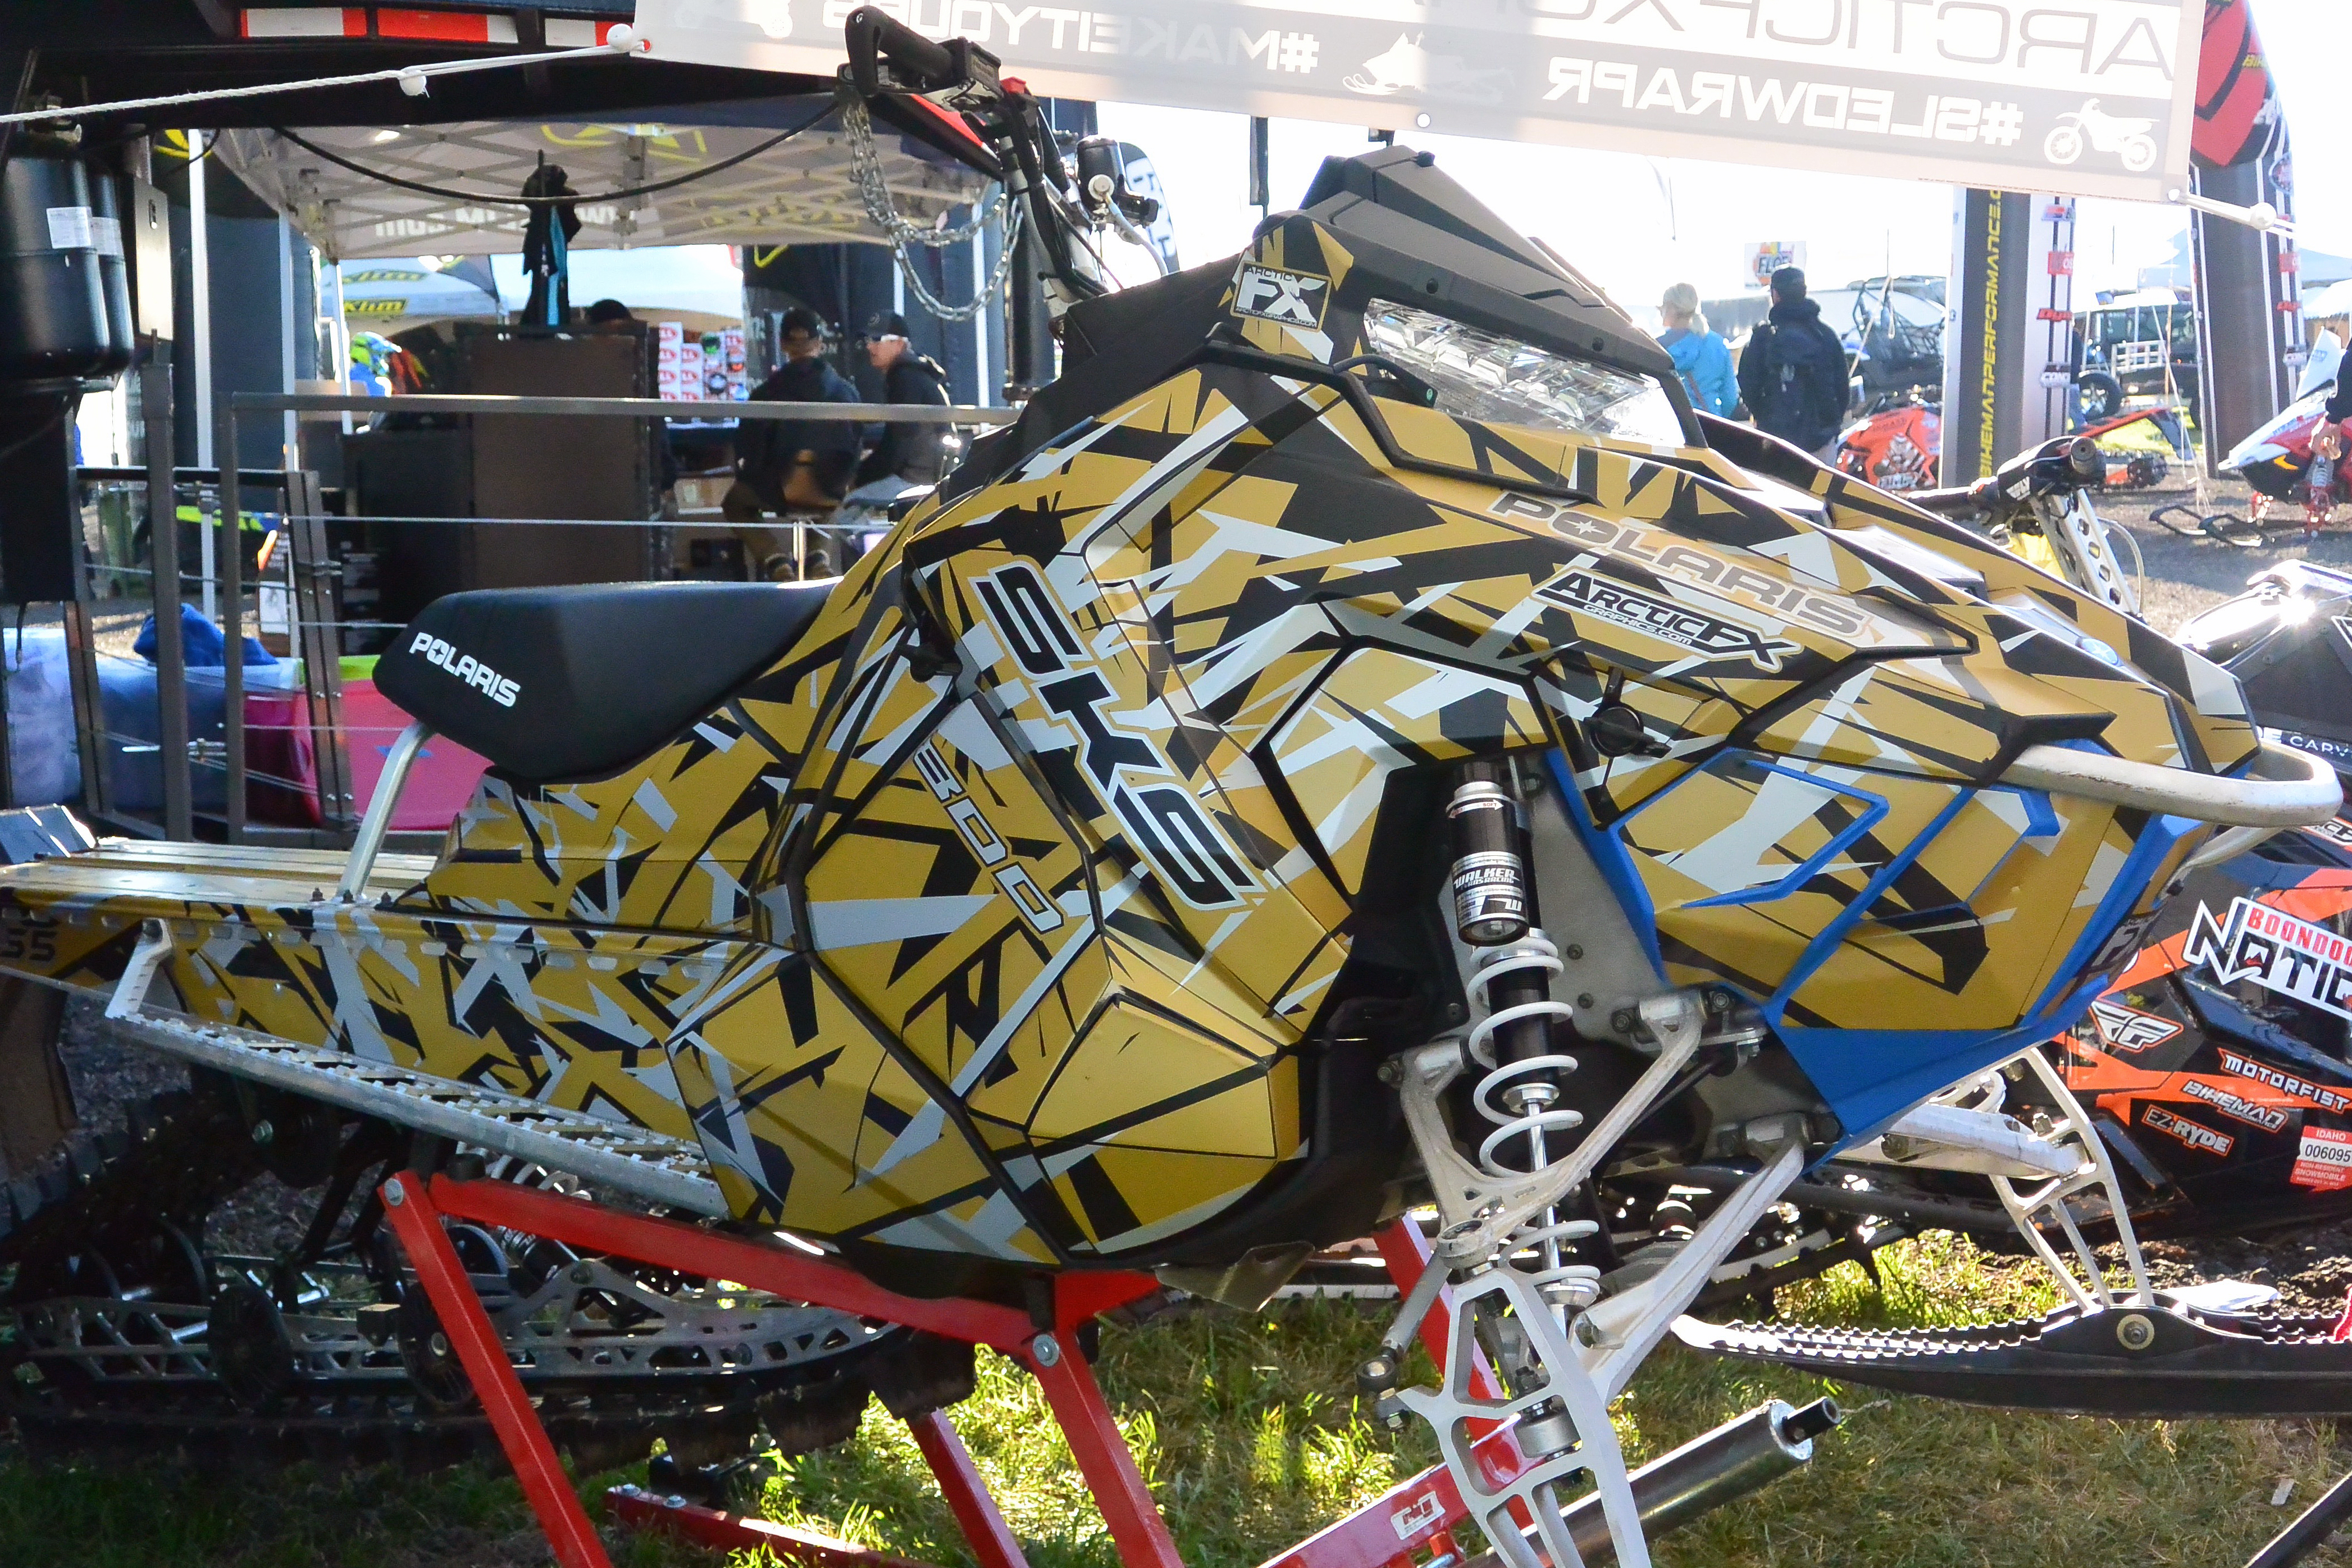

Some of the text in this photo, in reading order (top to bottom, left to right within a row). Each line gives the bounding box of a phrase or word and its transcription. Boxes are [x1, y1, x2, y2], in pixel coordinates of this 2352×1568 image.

[1237, 272, 1327, 323] FX
[1247, 266, 1292, 281] ARCTIC
[1490, 492, 1871, 636] POLARIS
[1546, 571, 1799, 666] ARCTICFX
[408, 632, 521, 708] POLARIS
[969, 561, 1267, 910] SKS
[913, 744, 1063, 935] 800
[1453, 868, 1520, 889] WALKER
[2225, 1054, 2350, 1111] MOTORFIST
[2305, 1144, 2352, 1163] 006095
[2316, 1129, 2346, 1141] IDAHO
[2295, 1168, 2346, 1182] SNOWMOBILE
